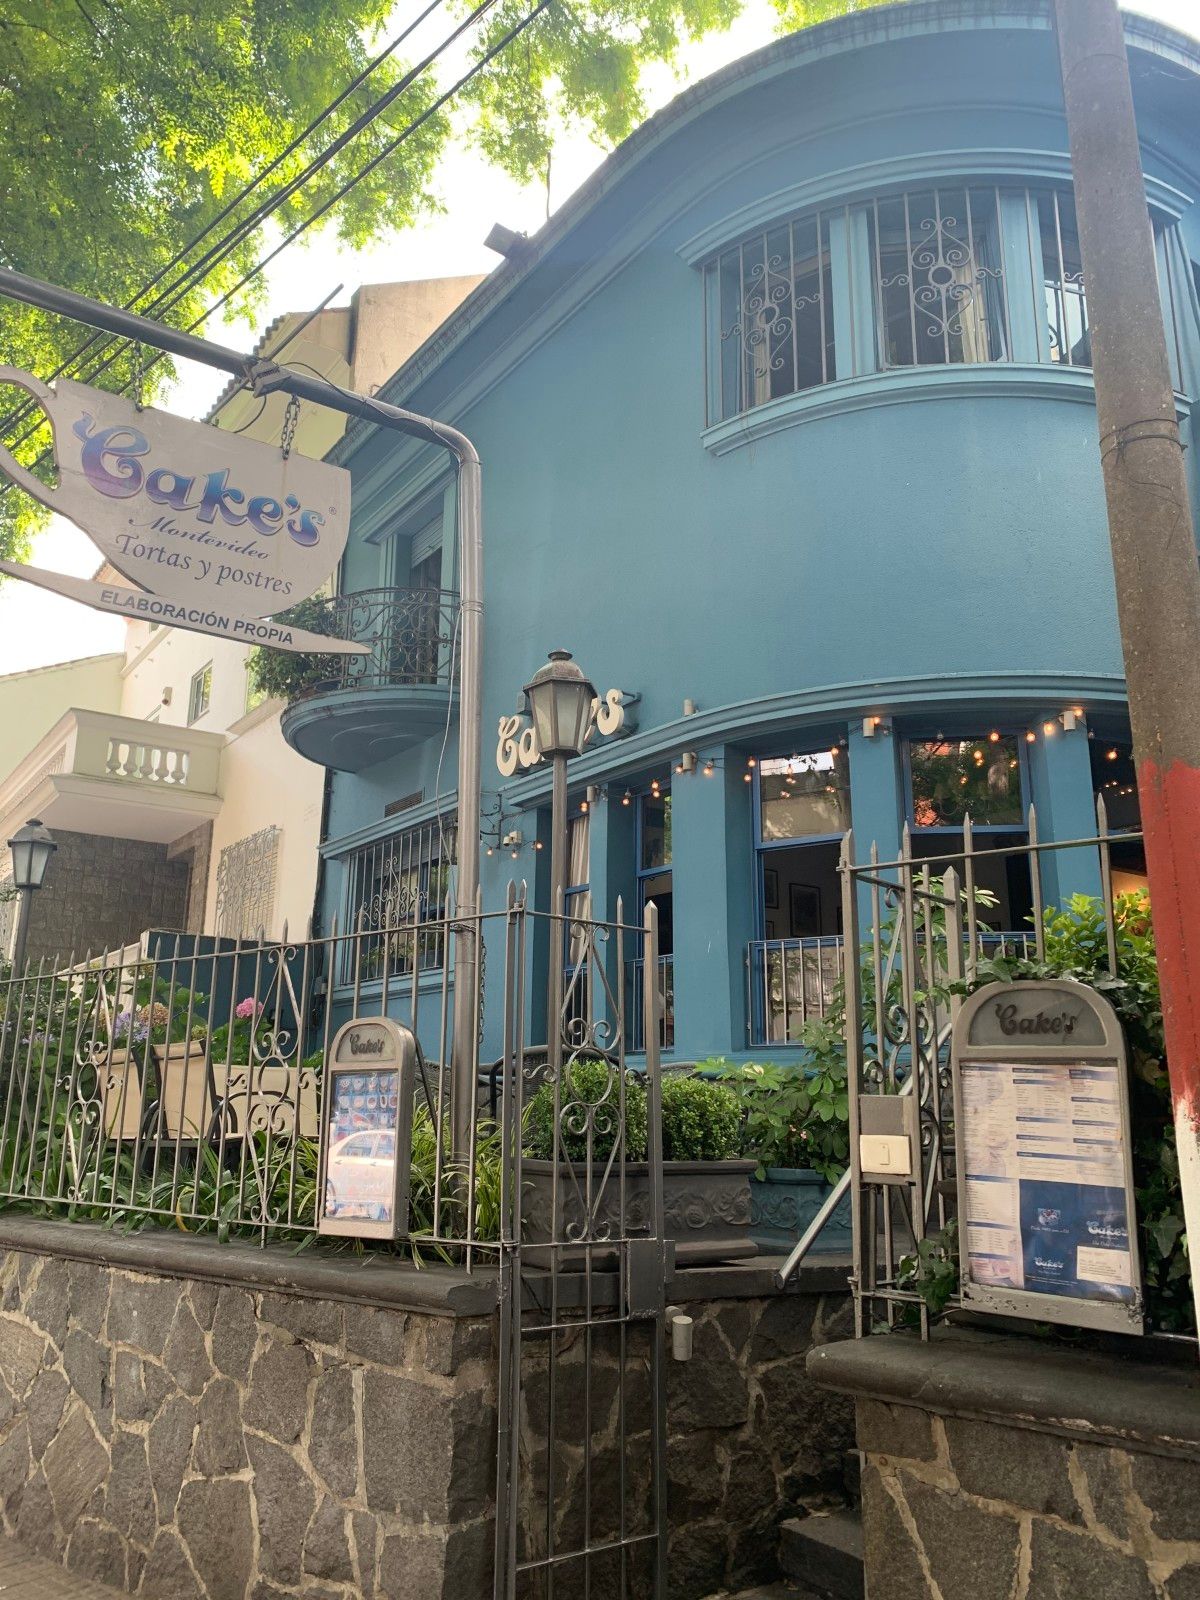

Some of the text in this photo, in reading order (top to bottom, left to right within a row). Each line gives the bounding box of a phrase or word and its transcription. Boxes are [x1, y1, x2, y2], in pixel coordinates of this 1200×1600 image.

[72, 411, 327, 548] Cake's
[115, 533, 293, 595] Tortas y postres
[129, 516, 270, 560] Montevideo
[100, 589, 293, 645] ELABORACIÓN PROPIA
[496, 688, 625, 778] Ca's
[350, 1033, 386, 1056] Cake's
[995, 1002, 1079, 1037] Cake's
